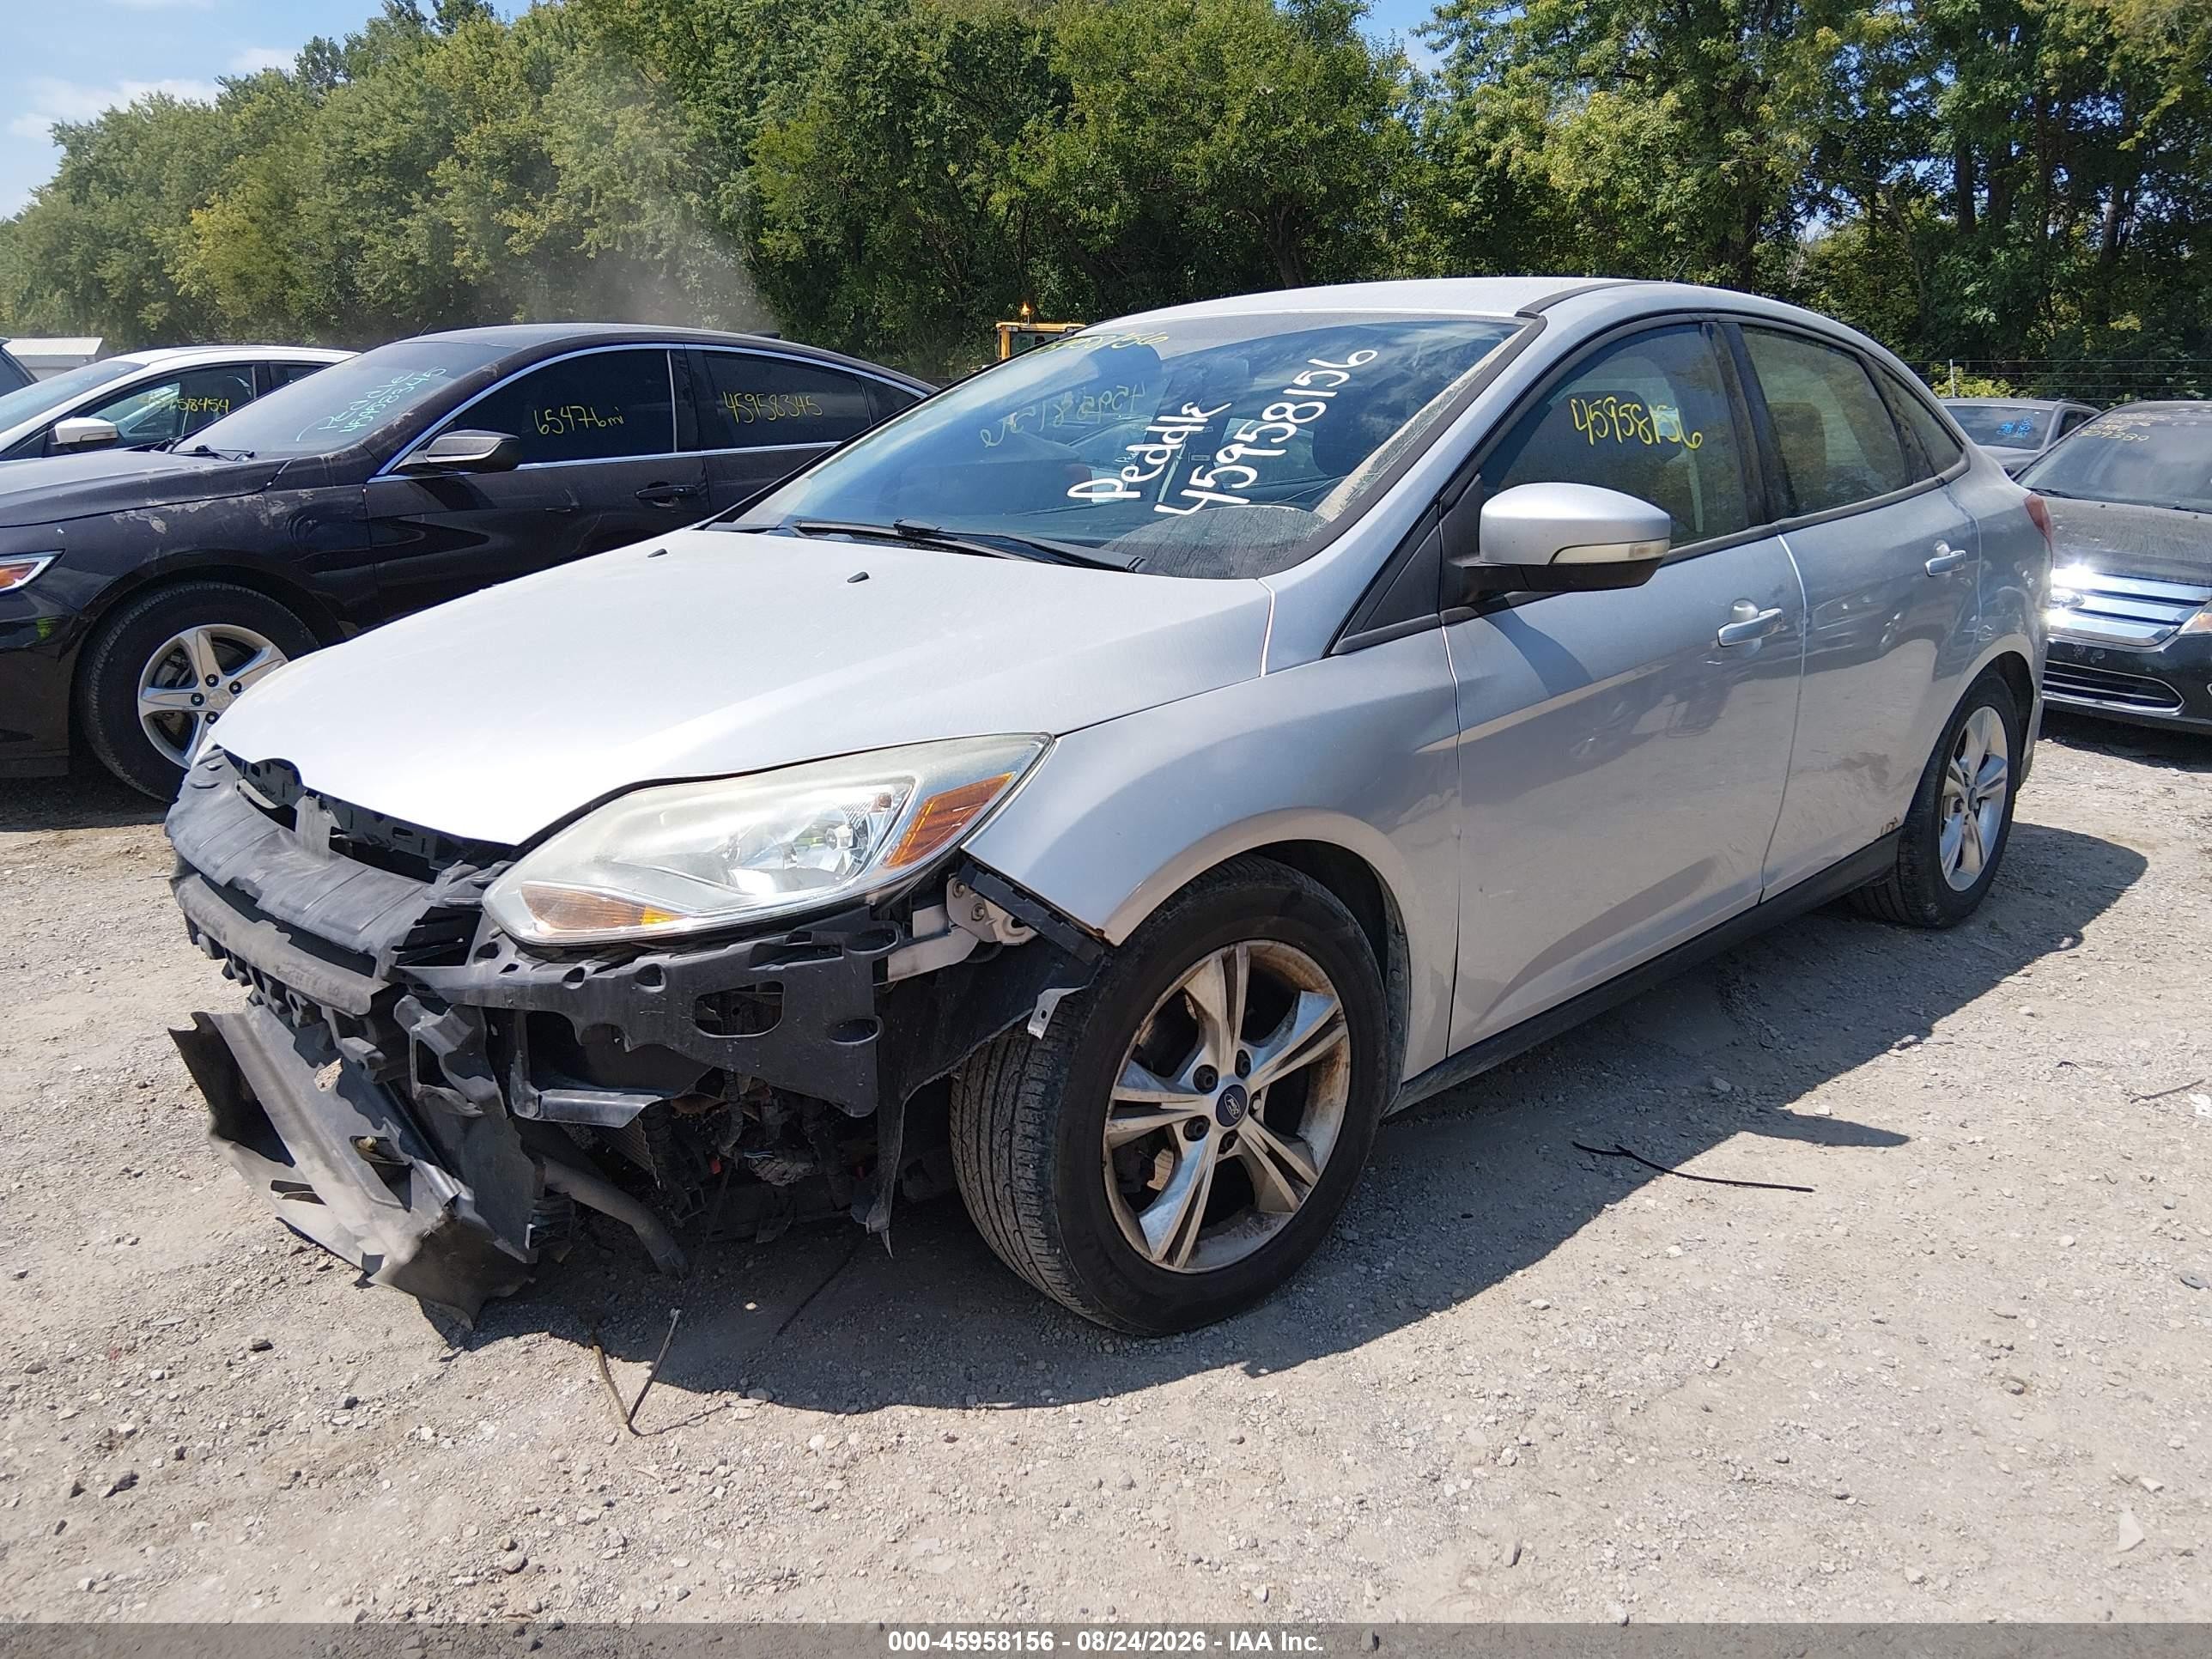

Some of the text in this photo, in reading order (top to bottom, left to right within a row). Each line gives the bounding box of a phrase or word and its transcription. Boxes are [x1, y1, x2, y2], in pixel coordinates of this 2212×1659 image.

[296, 372, 415, 441] Peddle
[722, 391, 823, 424] 45958345
[1154, 349, 1378, 515] 45958156
[1570, 396, 1703, 449] 45958156
[1066, 401, 1233, 499] Peddle
